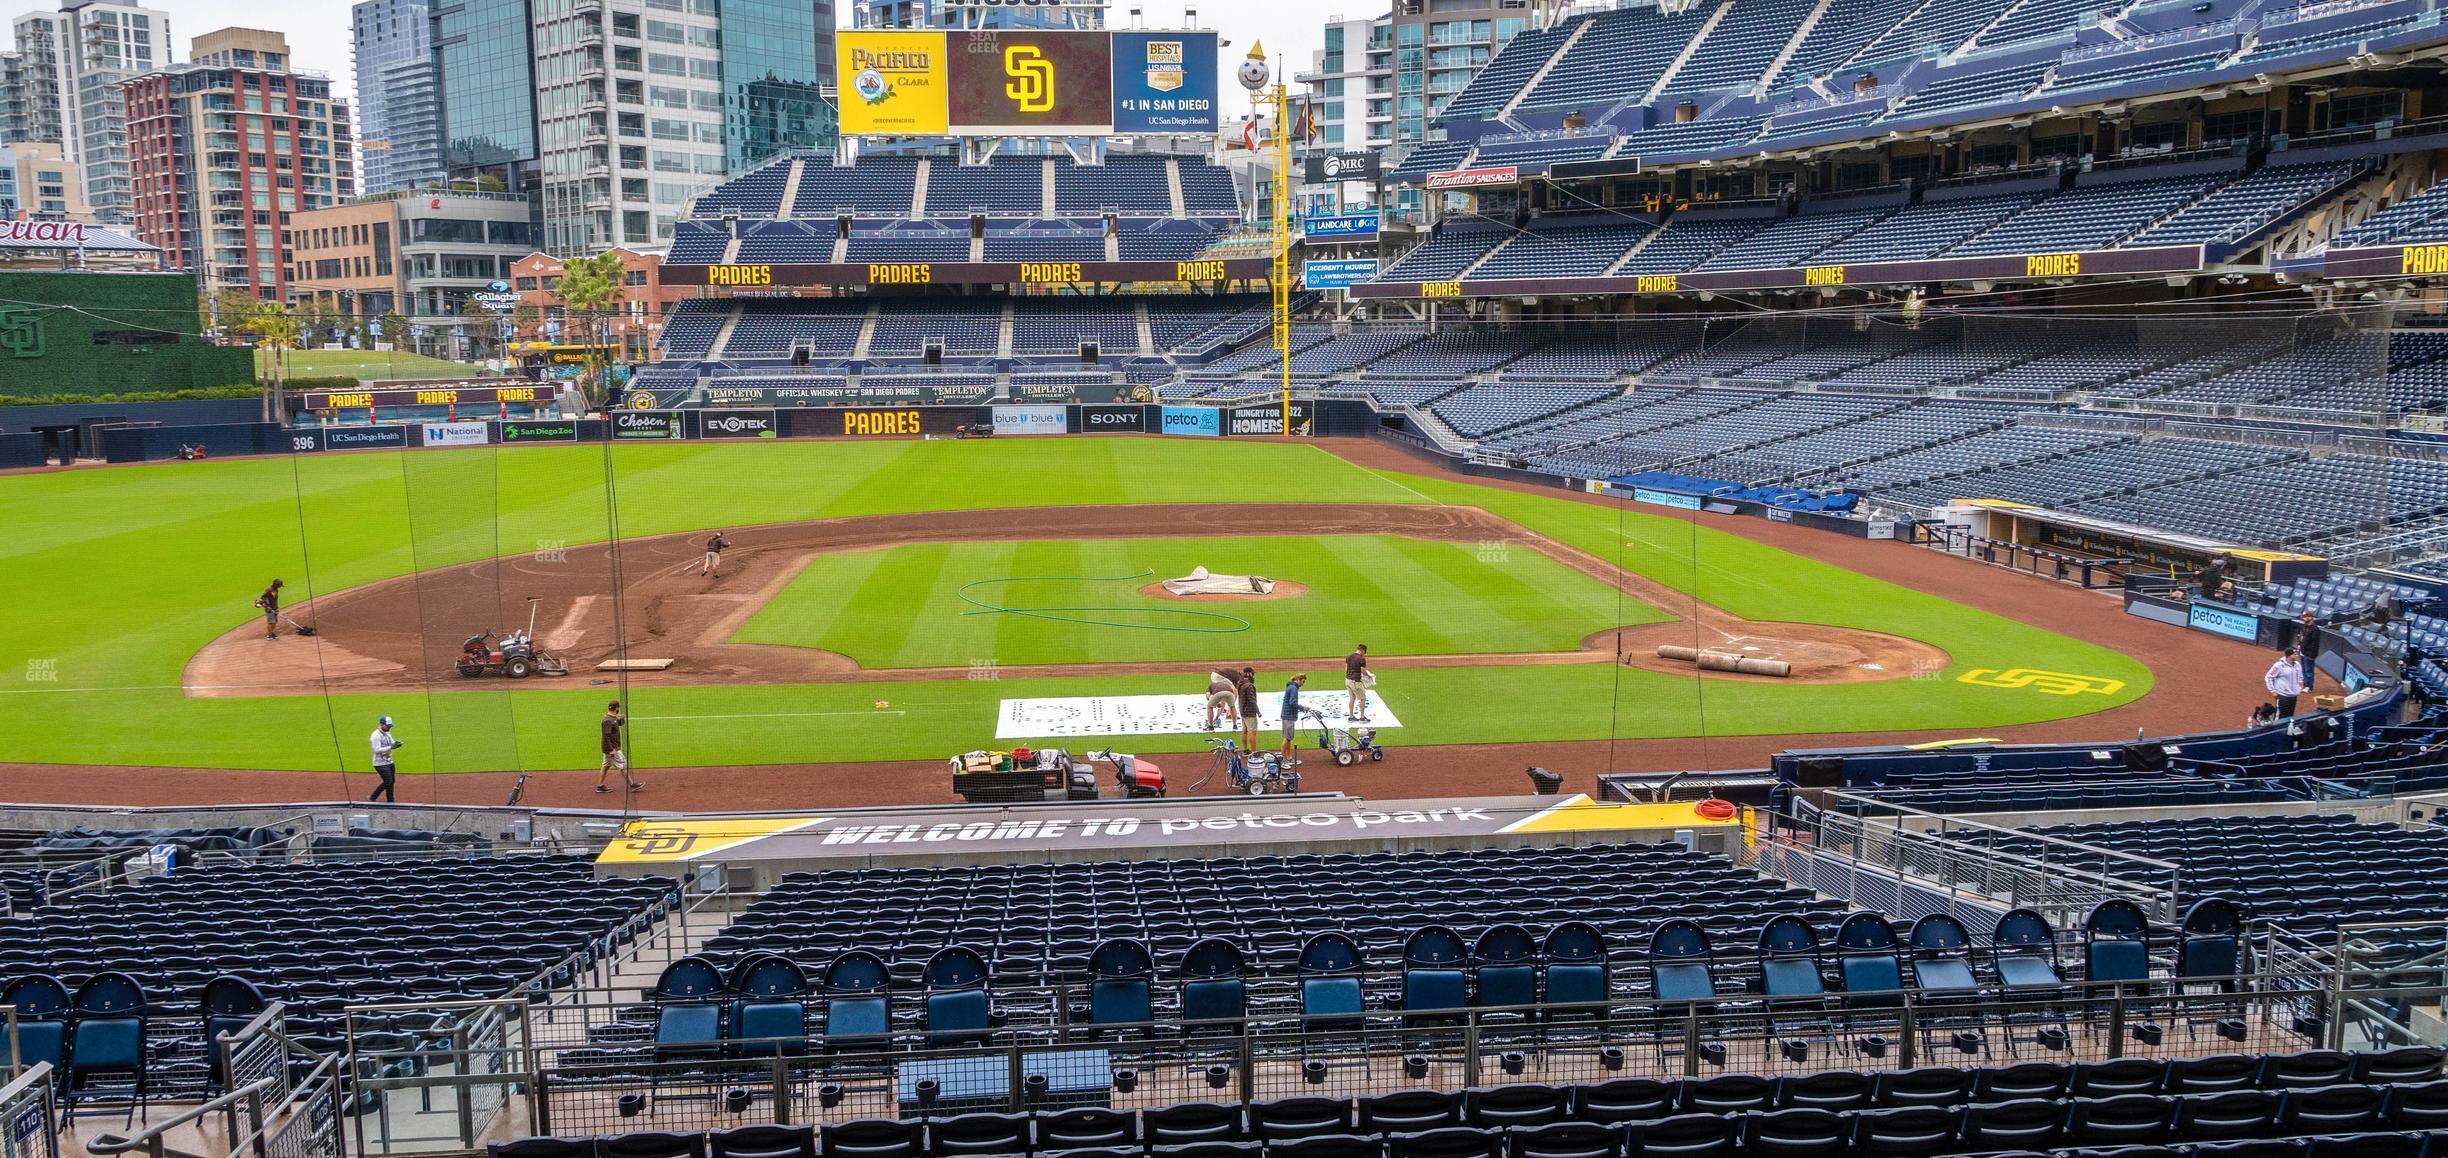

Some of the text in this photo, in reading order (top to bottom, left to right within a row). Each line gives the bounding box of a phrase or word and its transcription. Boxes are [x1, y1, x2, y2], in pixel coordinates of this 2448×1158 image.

[1149, 44, 1181, 54] BEST
[1149, 55, 1181, 63] HOSPITALS
[1122, 100, 1209, 110] #1 IN SAN DIEGO
[1148, 117, 1209, 126] UC San Diego Health
[1340, 158, 1365, 169] MRC
[1429, 173, 1515, 187] Tarantino SAUSAGES
[1317, 218, 1377, 230] LANDCARE LOGIC
[1177, 260, 1225, 280] PADRES
[2027, 253, 2080, 276] PADRES
[709, 265, 771, 285] PADRES
[869, 264, 931, 283] PADRES
[1021, 263, 1081, 282] PADRES
[1806, 266, 1844, 285] PADRES
[1422, 281, 1461, 297] PADRES
[1638, 275, 1677, 292] PADRES
[474, 291, 522, 304] Gallagher
[481, 301, 515, 311] Square
[707, 390, 763, 399] TEMPLETON
[811, 389, 843, 397] WHISKEY
[860, 388, 875, 396] SAN
[875, 388, 894, 396] DIEGO
[895, 388, 920, 396] PADRES
[932, 386, 988, 396] TEMPLETON
[1020, 385, 1075, 395] TEMPLETON
[328, 393, 372, 408] PADRES
[1235, 409, 1280, 418] HUNGRY FOR
[1289, 406, 1302, 417] 322
[618, 413, 666, 427] Chosen
[844, 411, 920, 435] PADRES
[995, 414, 1017, 423] blue
[1031, 413, 1054, 423] blue
[1090, 413, 1138, 424] SONY
[1165, 413, 1198, 427] petco
[708, 417, 767, 432] EVOTEK
[1232, 419, 1284, 433] HOMERS
[332, 431, 400, 442] UC San Diego Health
[447, 426, 484, 436] National
[535, 428, 557, 436] Diego
[293, 436, 315, 450] 396
[2193, 609, 2223, 626] petco
[2233, 619, 2250, 627] HEALTH
[2224, 623, 2246, 632] WELLNESS
[820, 806, 1496, 846] WELCOME TO petco park
[21, 1112, 38, 1132] 110
